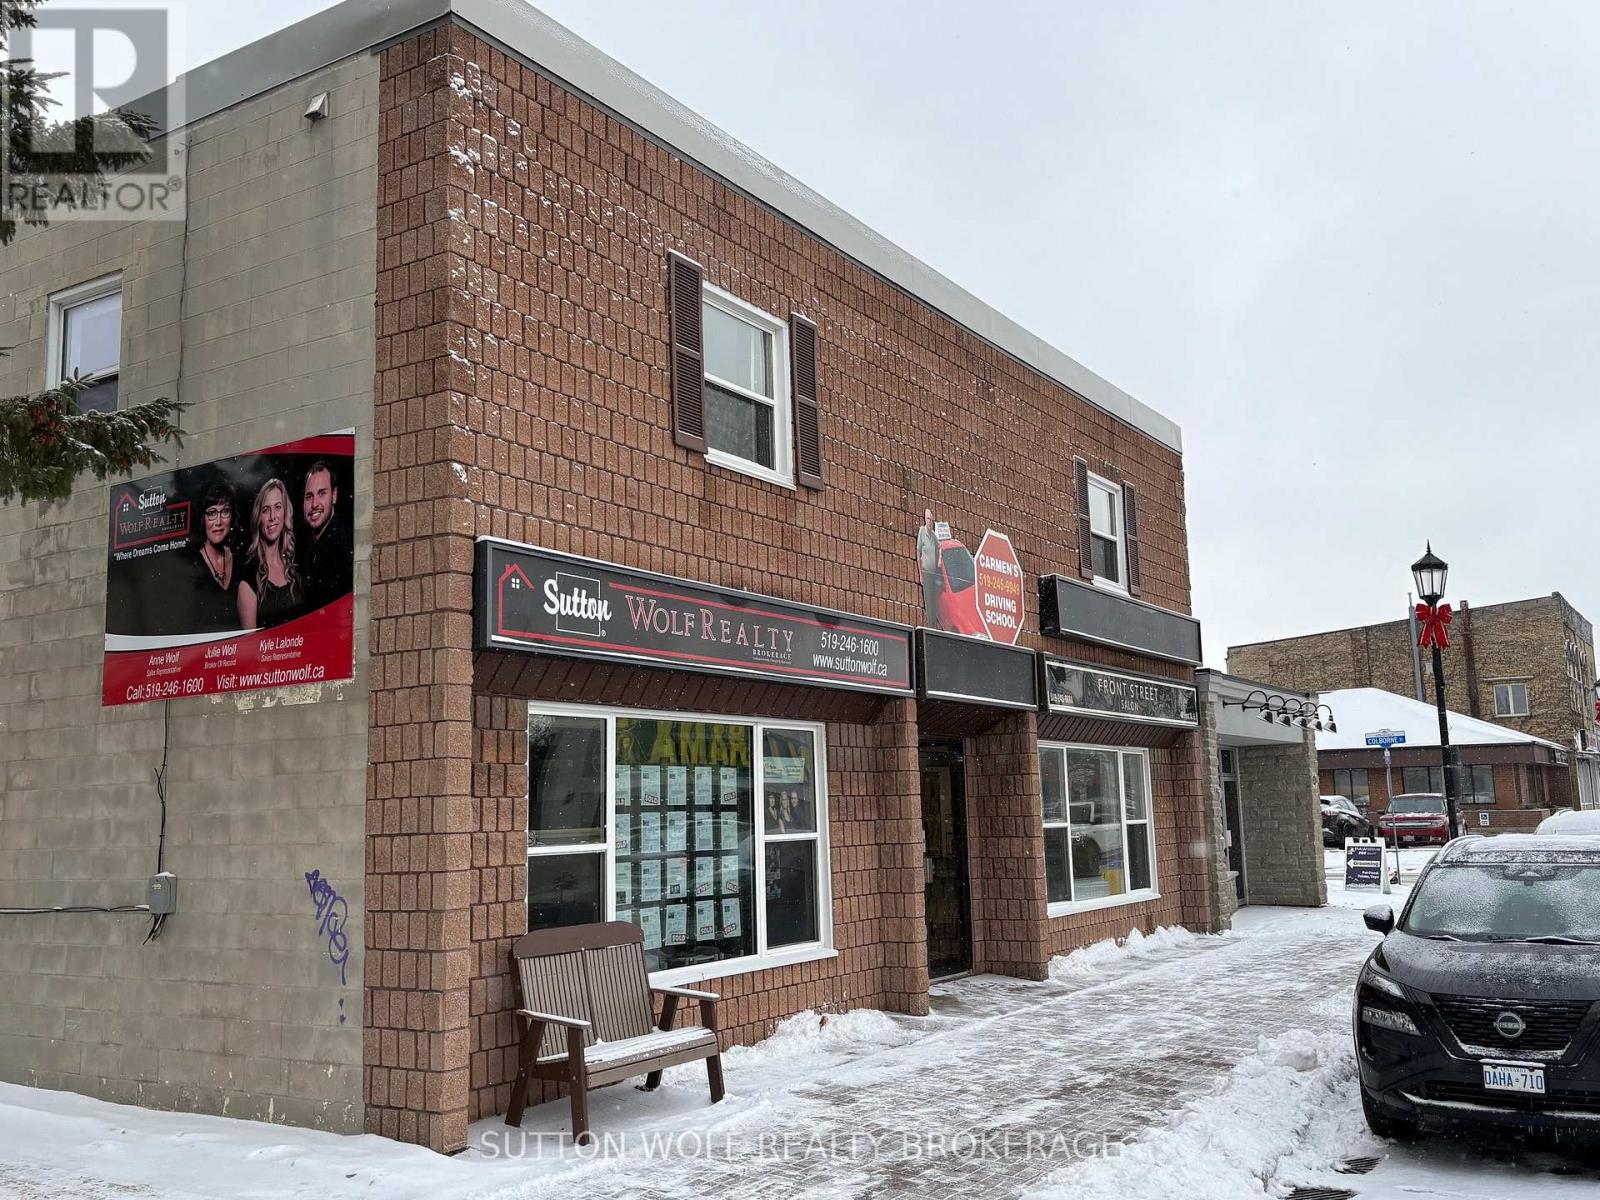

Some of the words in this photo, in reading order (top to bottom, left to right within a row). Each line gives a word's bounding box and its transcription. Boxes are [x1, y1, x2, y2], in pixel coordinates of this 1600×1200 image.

[138, 493, 166, 510] Sutton
[133, 547, 153, 557] Dreams
[153, 543, 169, 553] Come
[979, 554, 1019, 577] CARMEN'S
[543, 578, 612, 622] Sutton
[984, 593, 1017, 612] DRIVING
[985, 610, 1017, 629] SCHOOL
[204, 646, 221, 659] Julie
[222, 643, 238, 656] Wolf
[259, 639, 274, 653] Kyle
[275, 635, 304, 649] Lalonde
[820, 631, 879, 656] 519-246-1600
[149, 655, 165, 666] Anne
[165, 651, 180, 664] Wolf
[752, 648, 792, 661] BROKERAGE
[812, 653, 888, 676] www.suttonwolf.ca
[126, 685, 145, 700] Call:
[145, 677, 204, 698] 519-246-1600
[216, 673, 238, 689] Visit:
[239, 663, 325, 686] www.suttonwolf.ca
[1098, 678, 1127, 698] FRONT
[1129, 684, 1158, 701] STREET
[1120, 699, 1139, 712] SALON
[1367, 736, 1399, 745] COLBORNE
